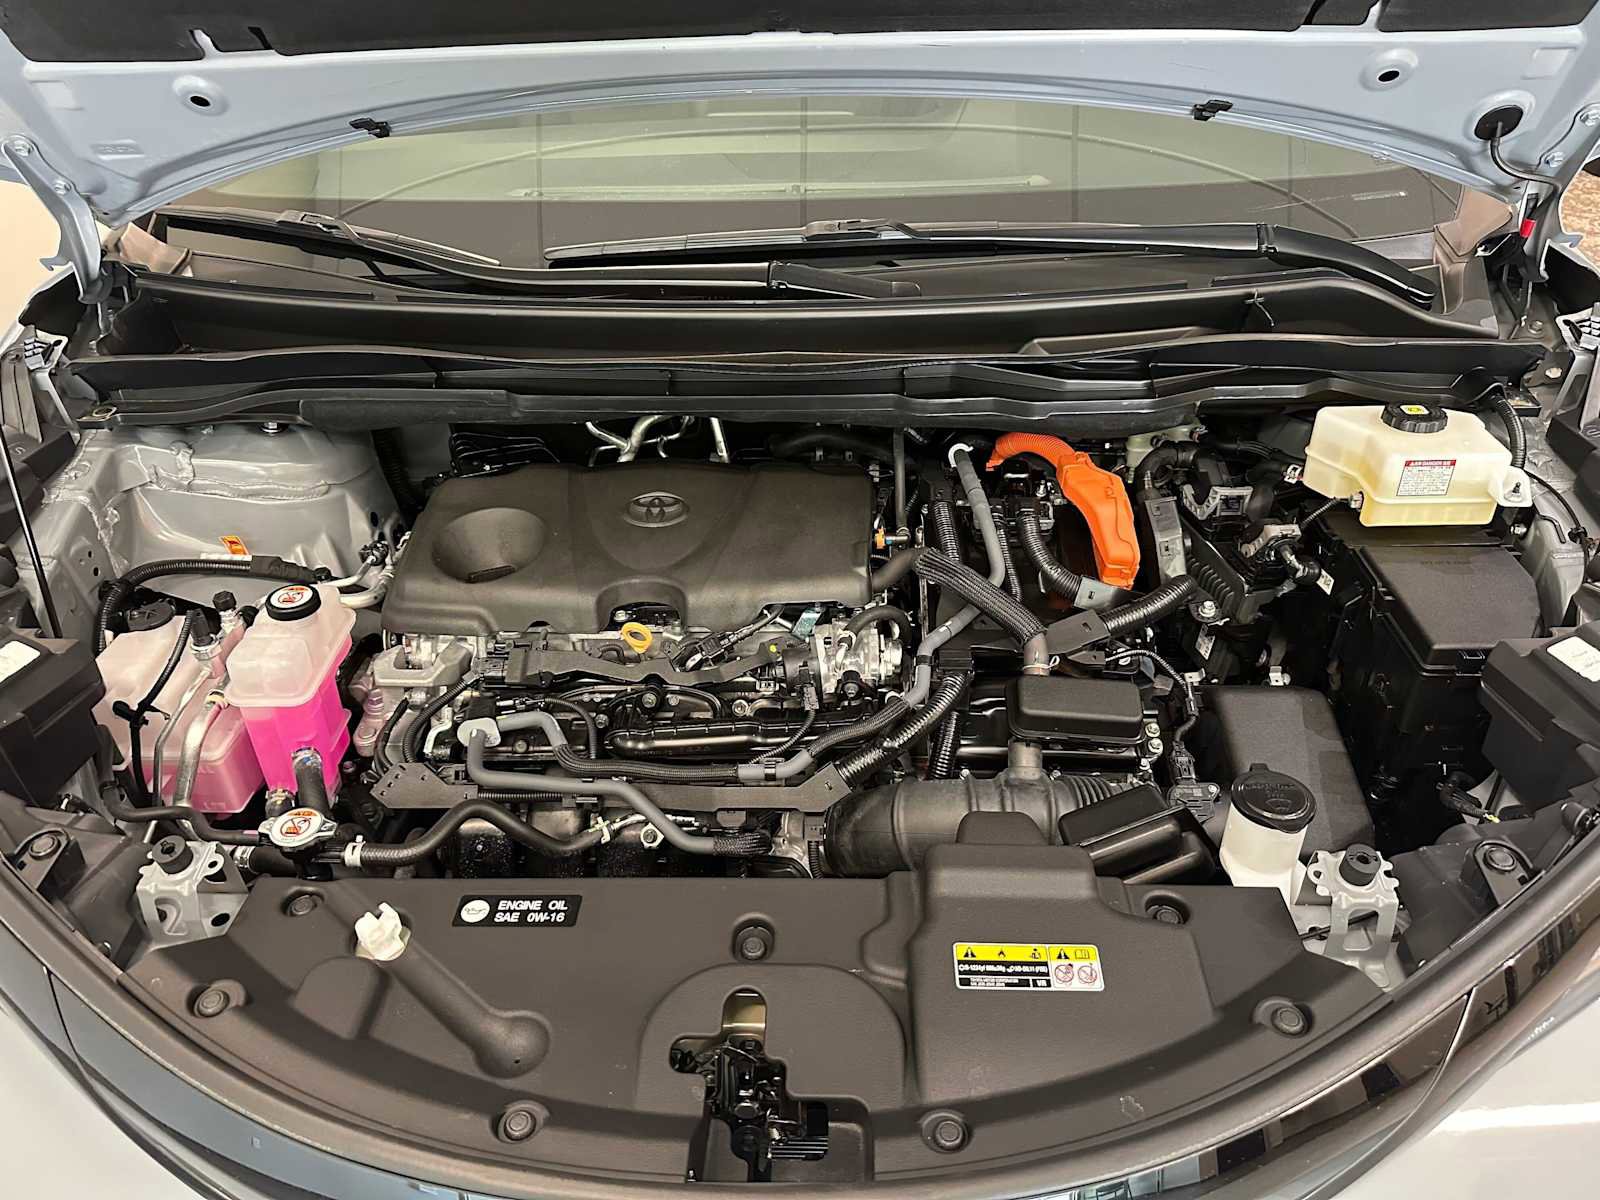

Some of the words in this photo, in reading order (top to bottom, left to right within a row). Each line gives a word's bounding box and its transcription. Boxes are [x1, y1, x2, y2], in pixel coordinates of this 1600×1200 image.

[497, 900, 542, 911] ENGINE
[548, 900, 568, 911] OIL
[494, 912, 520, 922] SAE
[527, 912, 565, 922] 0W-16
